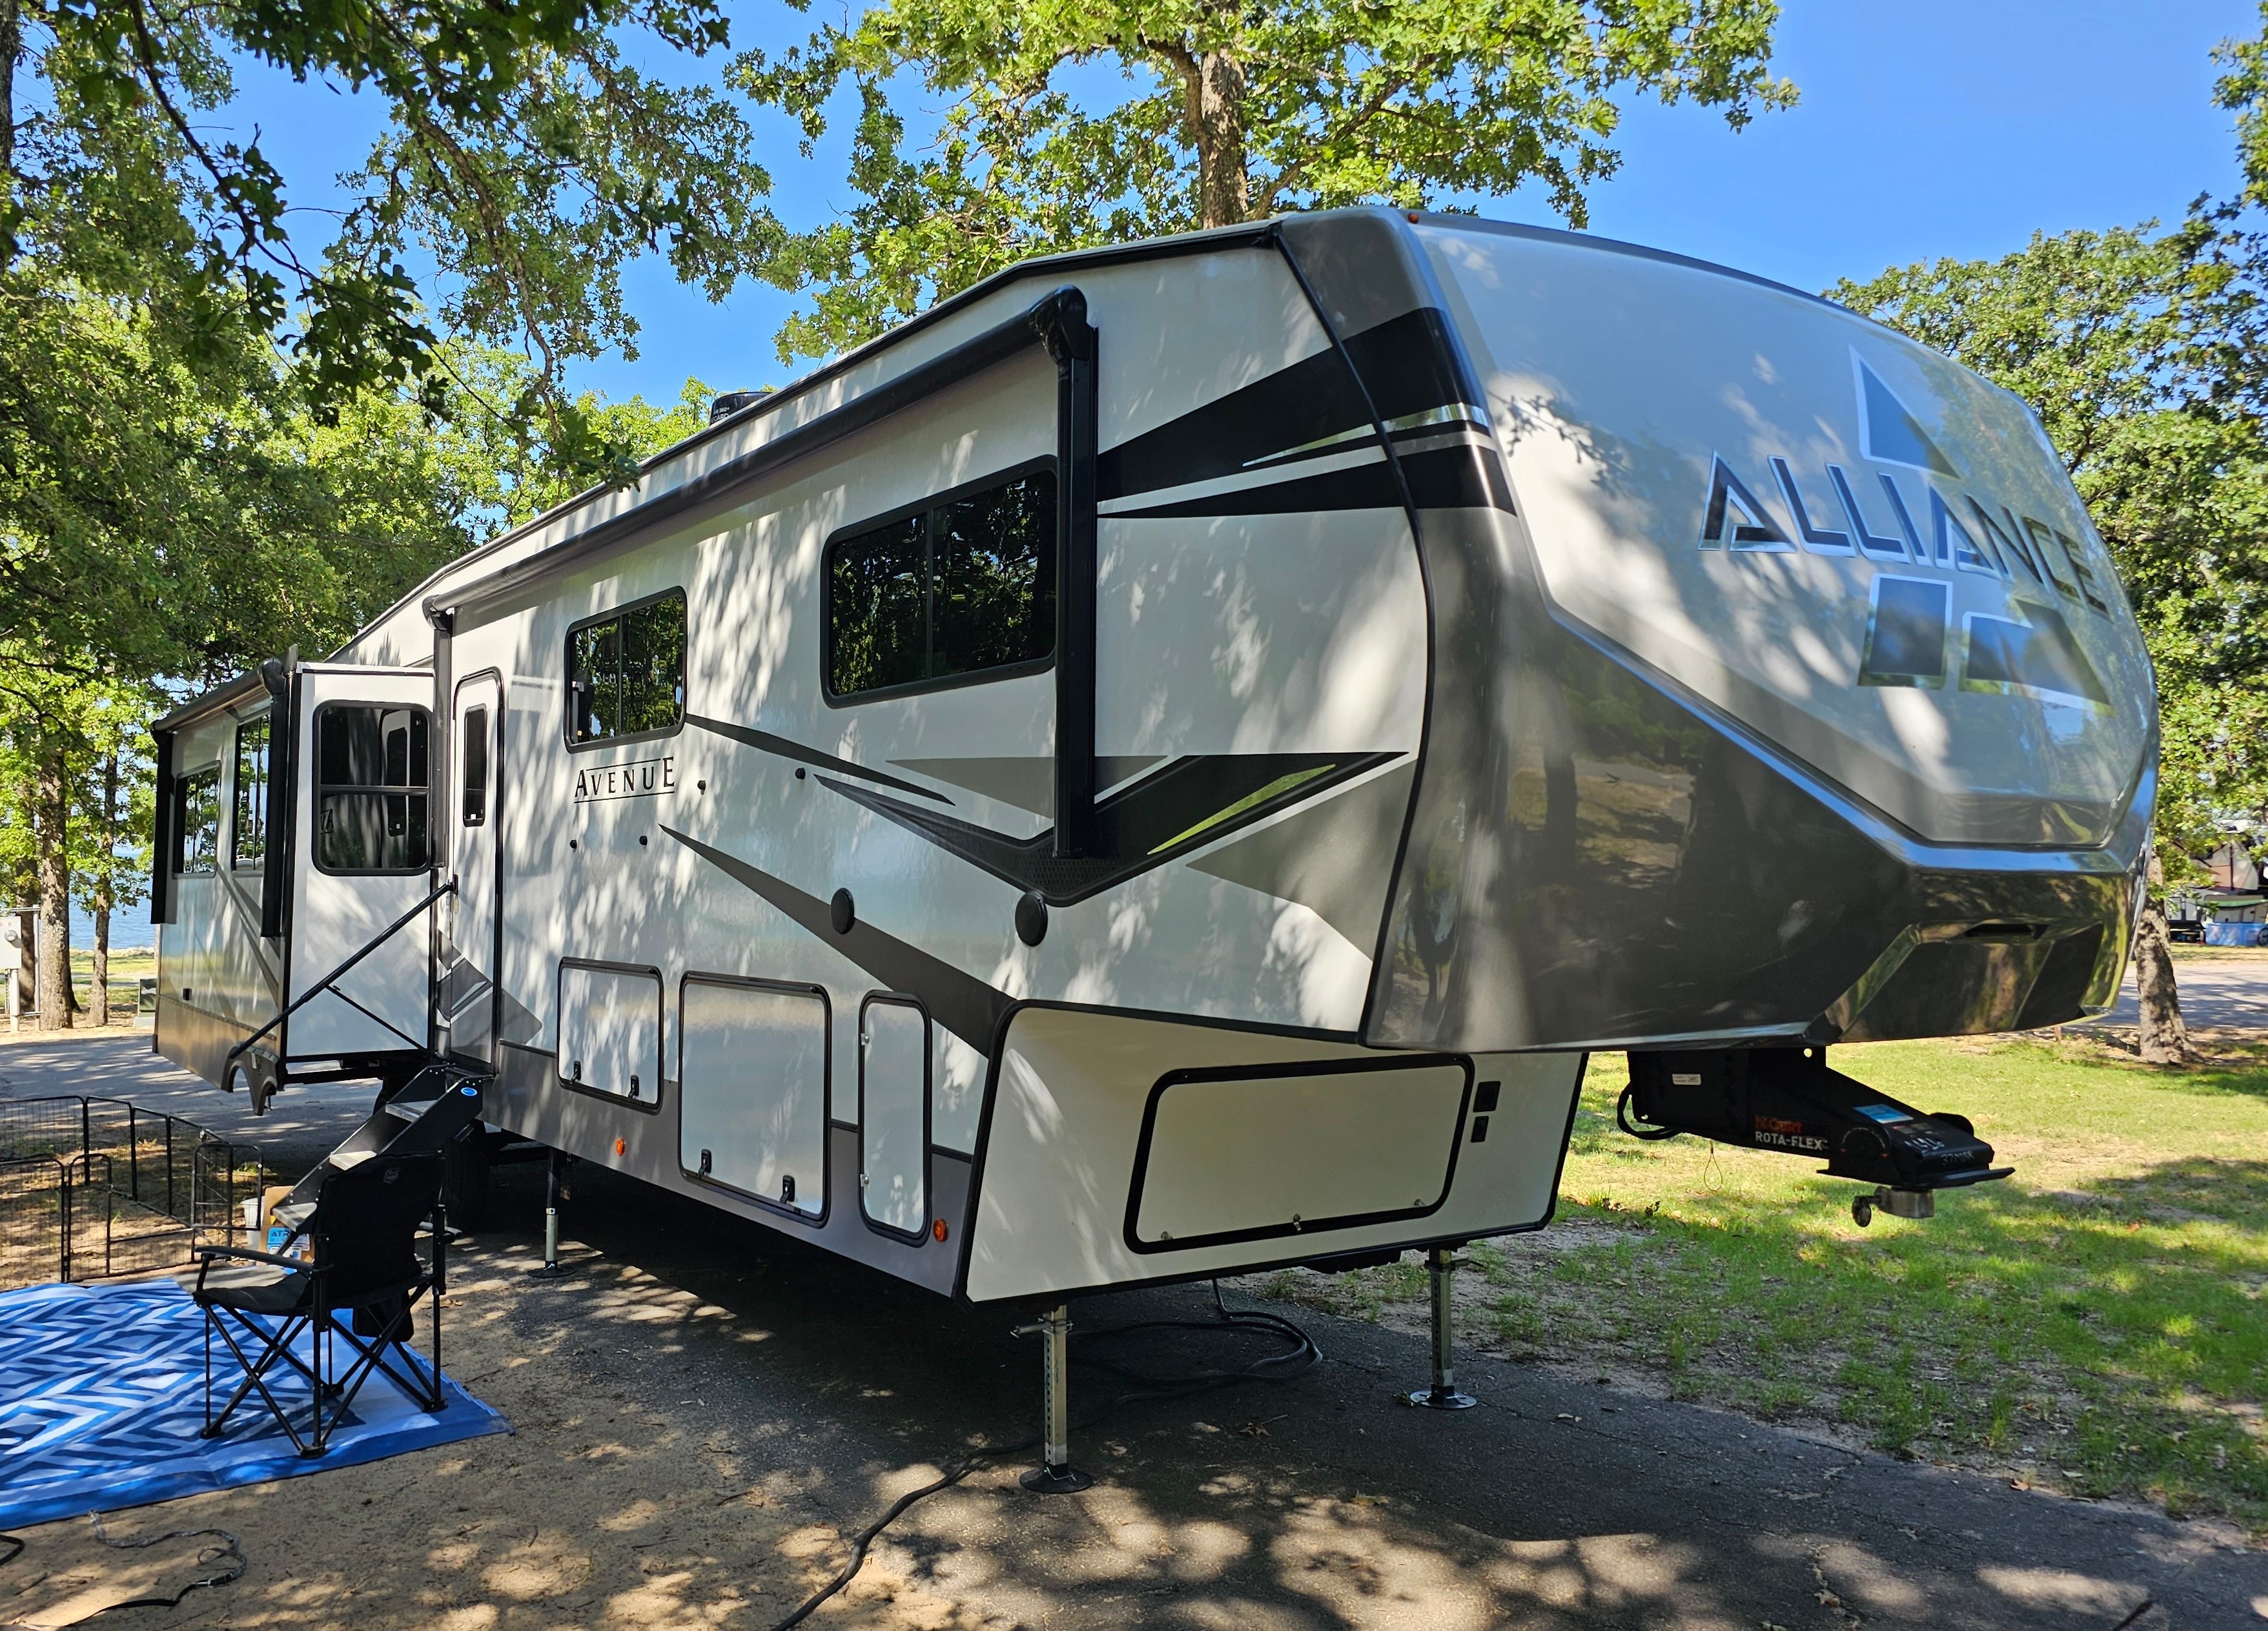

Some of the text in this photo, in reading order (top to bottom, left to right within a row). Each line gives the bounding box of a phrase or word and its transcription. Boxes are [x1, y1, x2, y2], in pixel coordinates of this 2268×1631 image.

[1698, 451, 2113, 623] ALLIANCE
[575, 757, 675, 797] AVENUE
[1755, 1131, 1823, 1151] ROTA-FLEX
